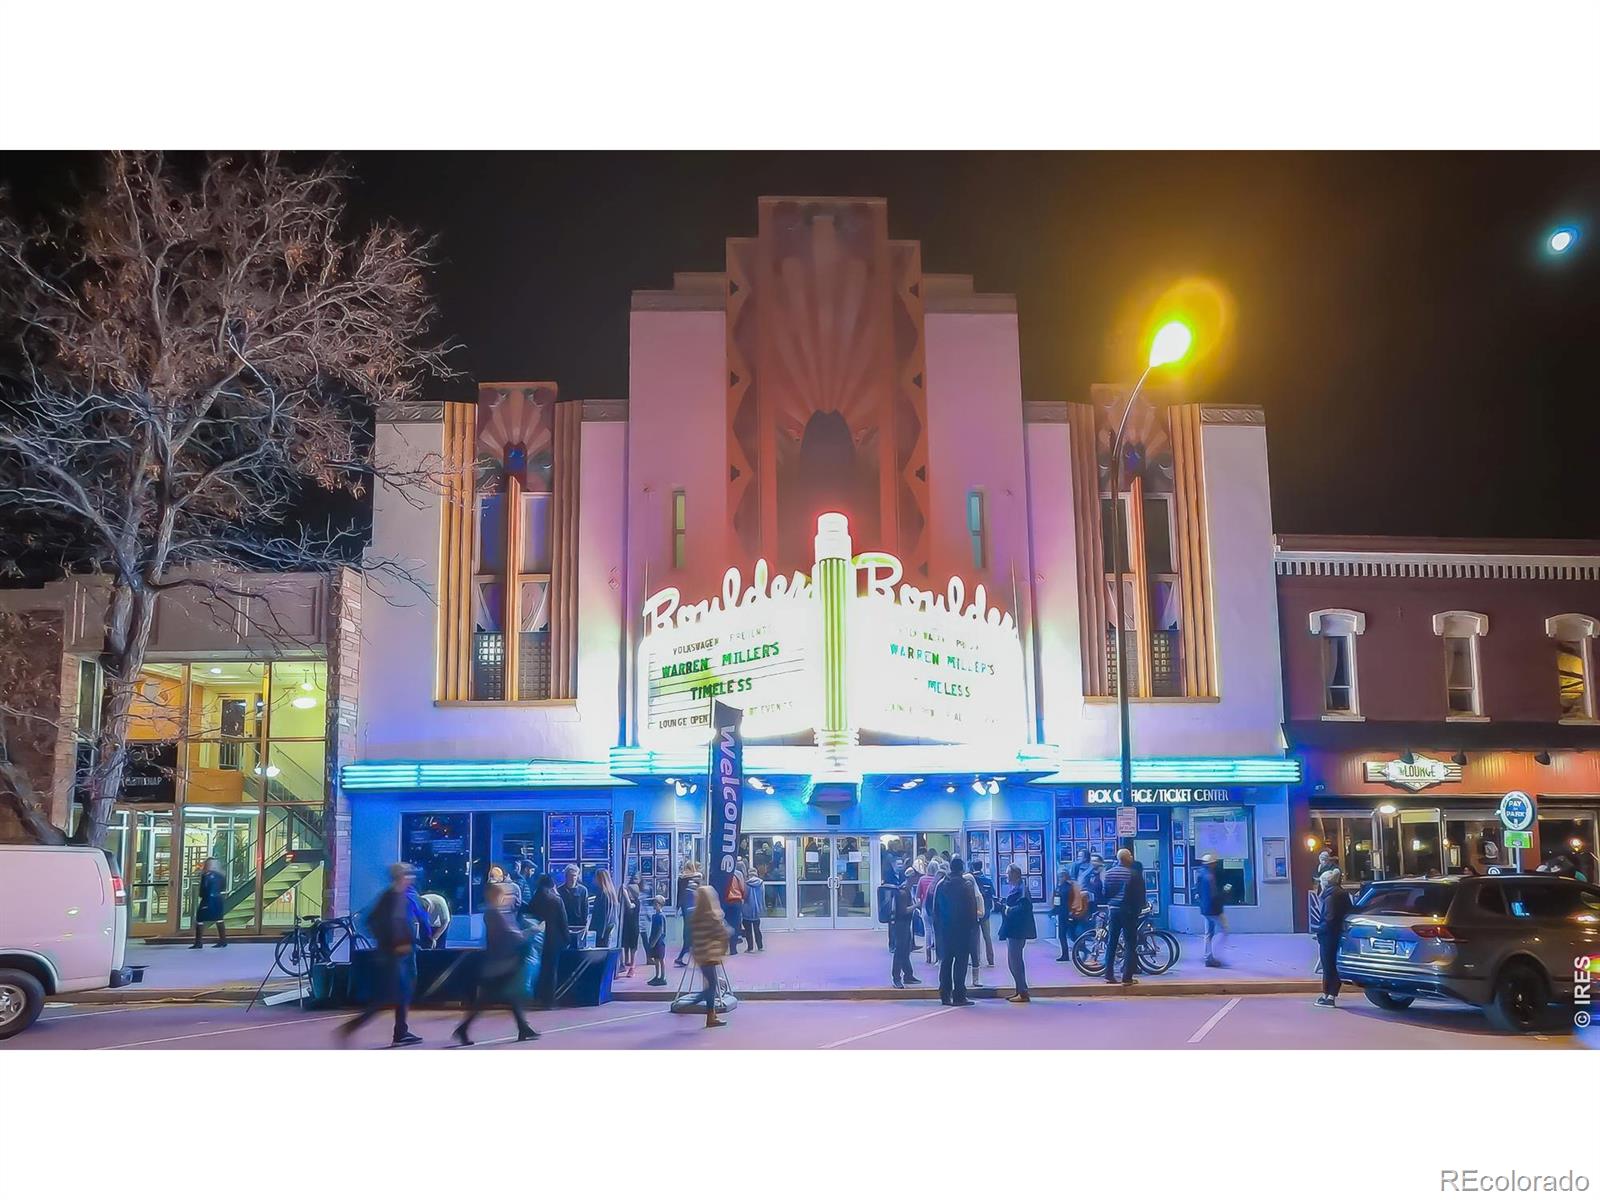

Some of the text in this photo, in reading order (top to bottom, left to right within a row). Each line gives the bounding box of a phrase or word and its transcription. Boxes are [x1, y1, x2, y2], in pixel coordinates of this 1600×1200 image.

[642, 558, 815, 629] Boulder
[890, 643, 939, 665] WARREN
[661, 657, 709, 678] WARREN
[690, 678, 752, 701] TIMELESS
[659, 716, 687, 729] LOUNGE
[690, 714, 708, 725] OPEN
[1404, 765, 1436, 777] LOUNGE
[1087, 788, 1229, 803] BOX OFICE/TICKET CENTER
